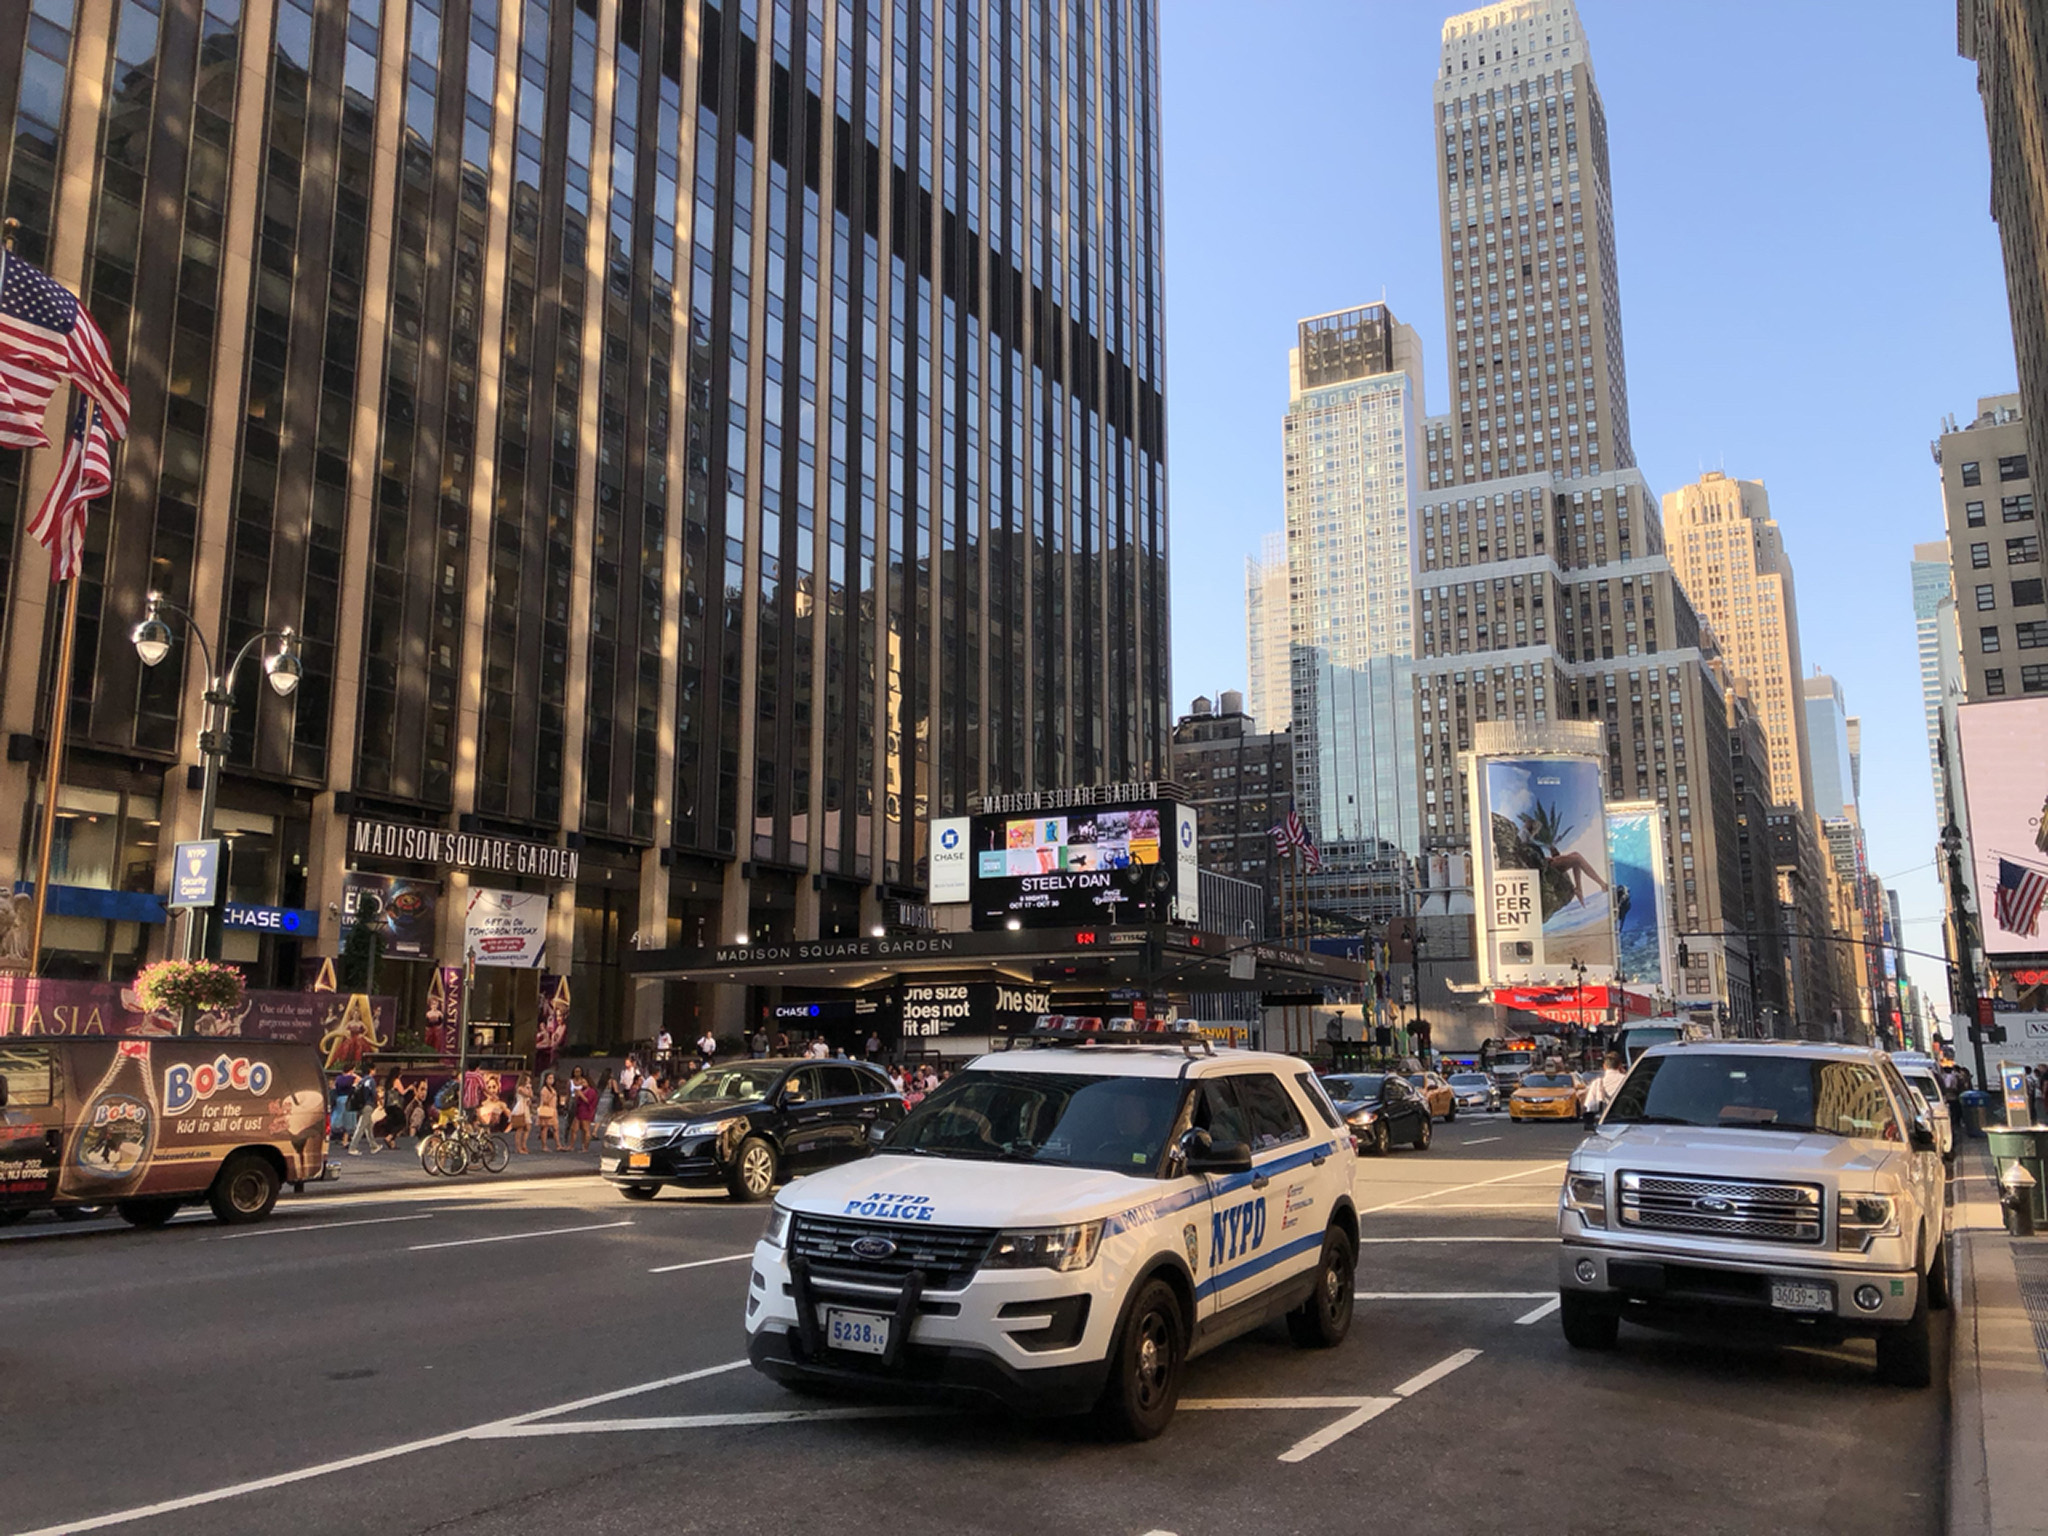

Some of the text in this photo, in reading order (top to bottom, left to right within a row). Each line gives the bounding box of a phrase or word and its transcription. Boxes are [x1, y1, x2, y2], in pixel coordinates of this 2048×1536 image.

[984, 782, 1158, 814] MADISON SQUARE GARDEN
[186, 848, 207, 859] NYPD
[354, 821, 579, 879] MADISON SQUARE GARDEN
[934, 852, 965, 862] CHASE
[1022, 874, 1111, 891] STEELY DAN
[1495, 883, 1529, 896] DIF
[1496, 898, 1531, 911] FER
[342, 916, 359, 925] LIV
[1497, 912, 1531, 925] ENT
[717, 939, 953, 961] MADISON SQUARE GARDEN
[1257, 947, 1277, 960] PENN
[935, 987, 968, 1000] size
[776, 1006, 809, 1017] CHASE
[903, 1001, 970, 1019] does not
[903, 1019, 919, 1036] fit
[920, 1019, 940, 1036] all
[163, 1053, 272, 1116] BOSCO
[2010, 1077, 2020, 1089] P
[202, 1103, 242, 1118] for the
[176, 1119, 194, 1134] kid
[198, 1118, 209, 1133] in
[212, 1117, 227, 1132] all
[229, 1116, 243, 1131] of
[245, 1115, 262, 1131] us!
[8, 1170, 20, 1180] NJ
[867, 1193, 930, 1204] NYPD
[844, 1200, 935, 1221] POLICE
[1121, 1204, 1159, 1231] POLICE
[1209, 1197, 1266, 1268] NYPD
[858, 1240, 885, 1252] Ford
[833, 1321, 884, 1345] 5238 16
